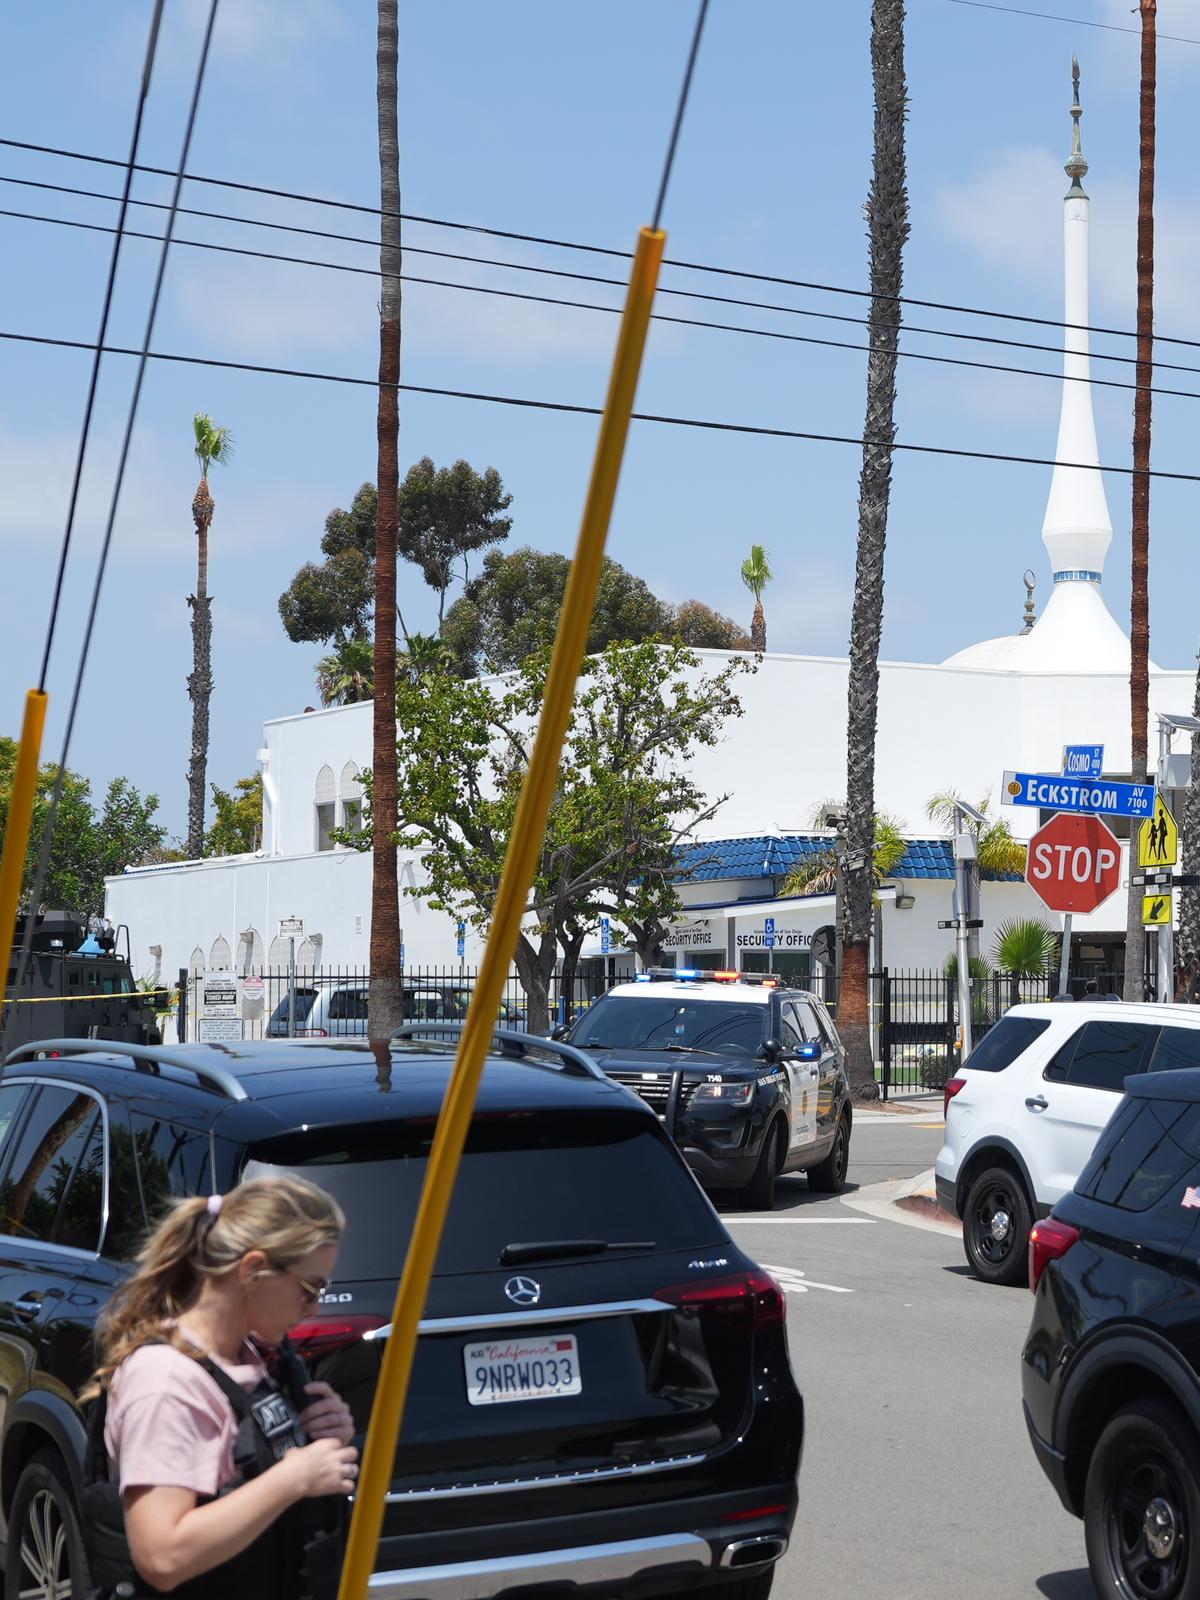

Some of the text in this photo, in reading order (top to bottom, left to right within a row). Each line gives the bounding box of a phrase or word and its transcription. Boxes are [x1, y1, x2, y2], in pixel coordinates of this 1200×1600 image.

[1068, 751, 1090, 772] COSMO
[1026, 779, 1118, 809] ECKSTROM
[1132, 787, 1145, 798] AV
[1127, 798, 1148, 809] 7100
[1032, 843, 1116, 884] STOP
[665, 932, 712, 946] SECURITY OFFICE
[786, 935, 812, 946] OFFIC
[707, 1074, 723, 1083] 7540
[318, 1292, 353, 1304] 50
[488, 1344, 552, 1362] California
[475, 1357, 573, 1395] 9NRW033
